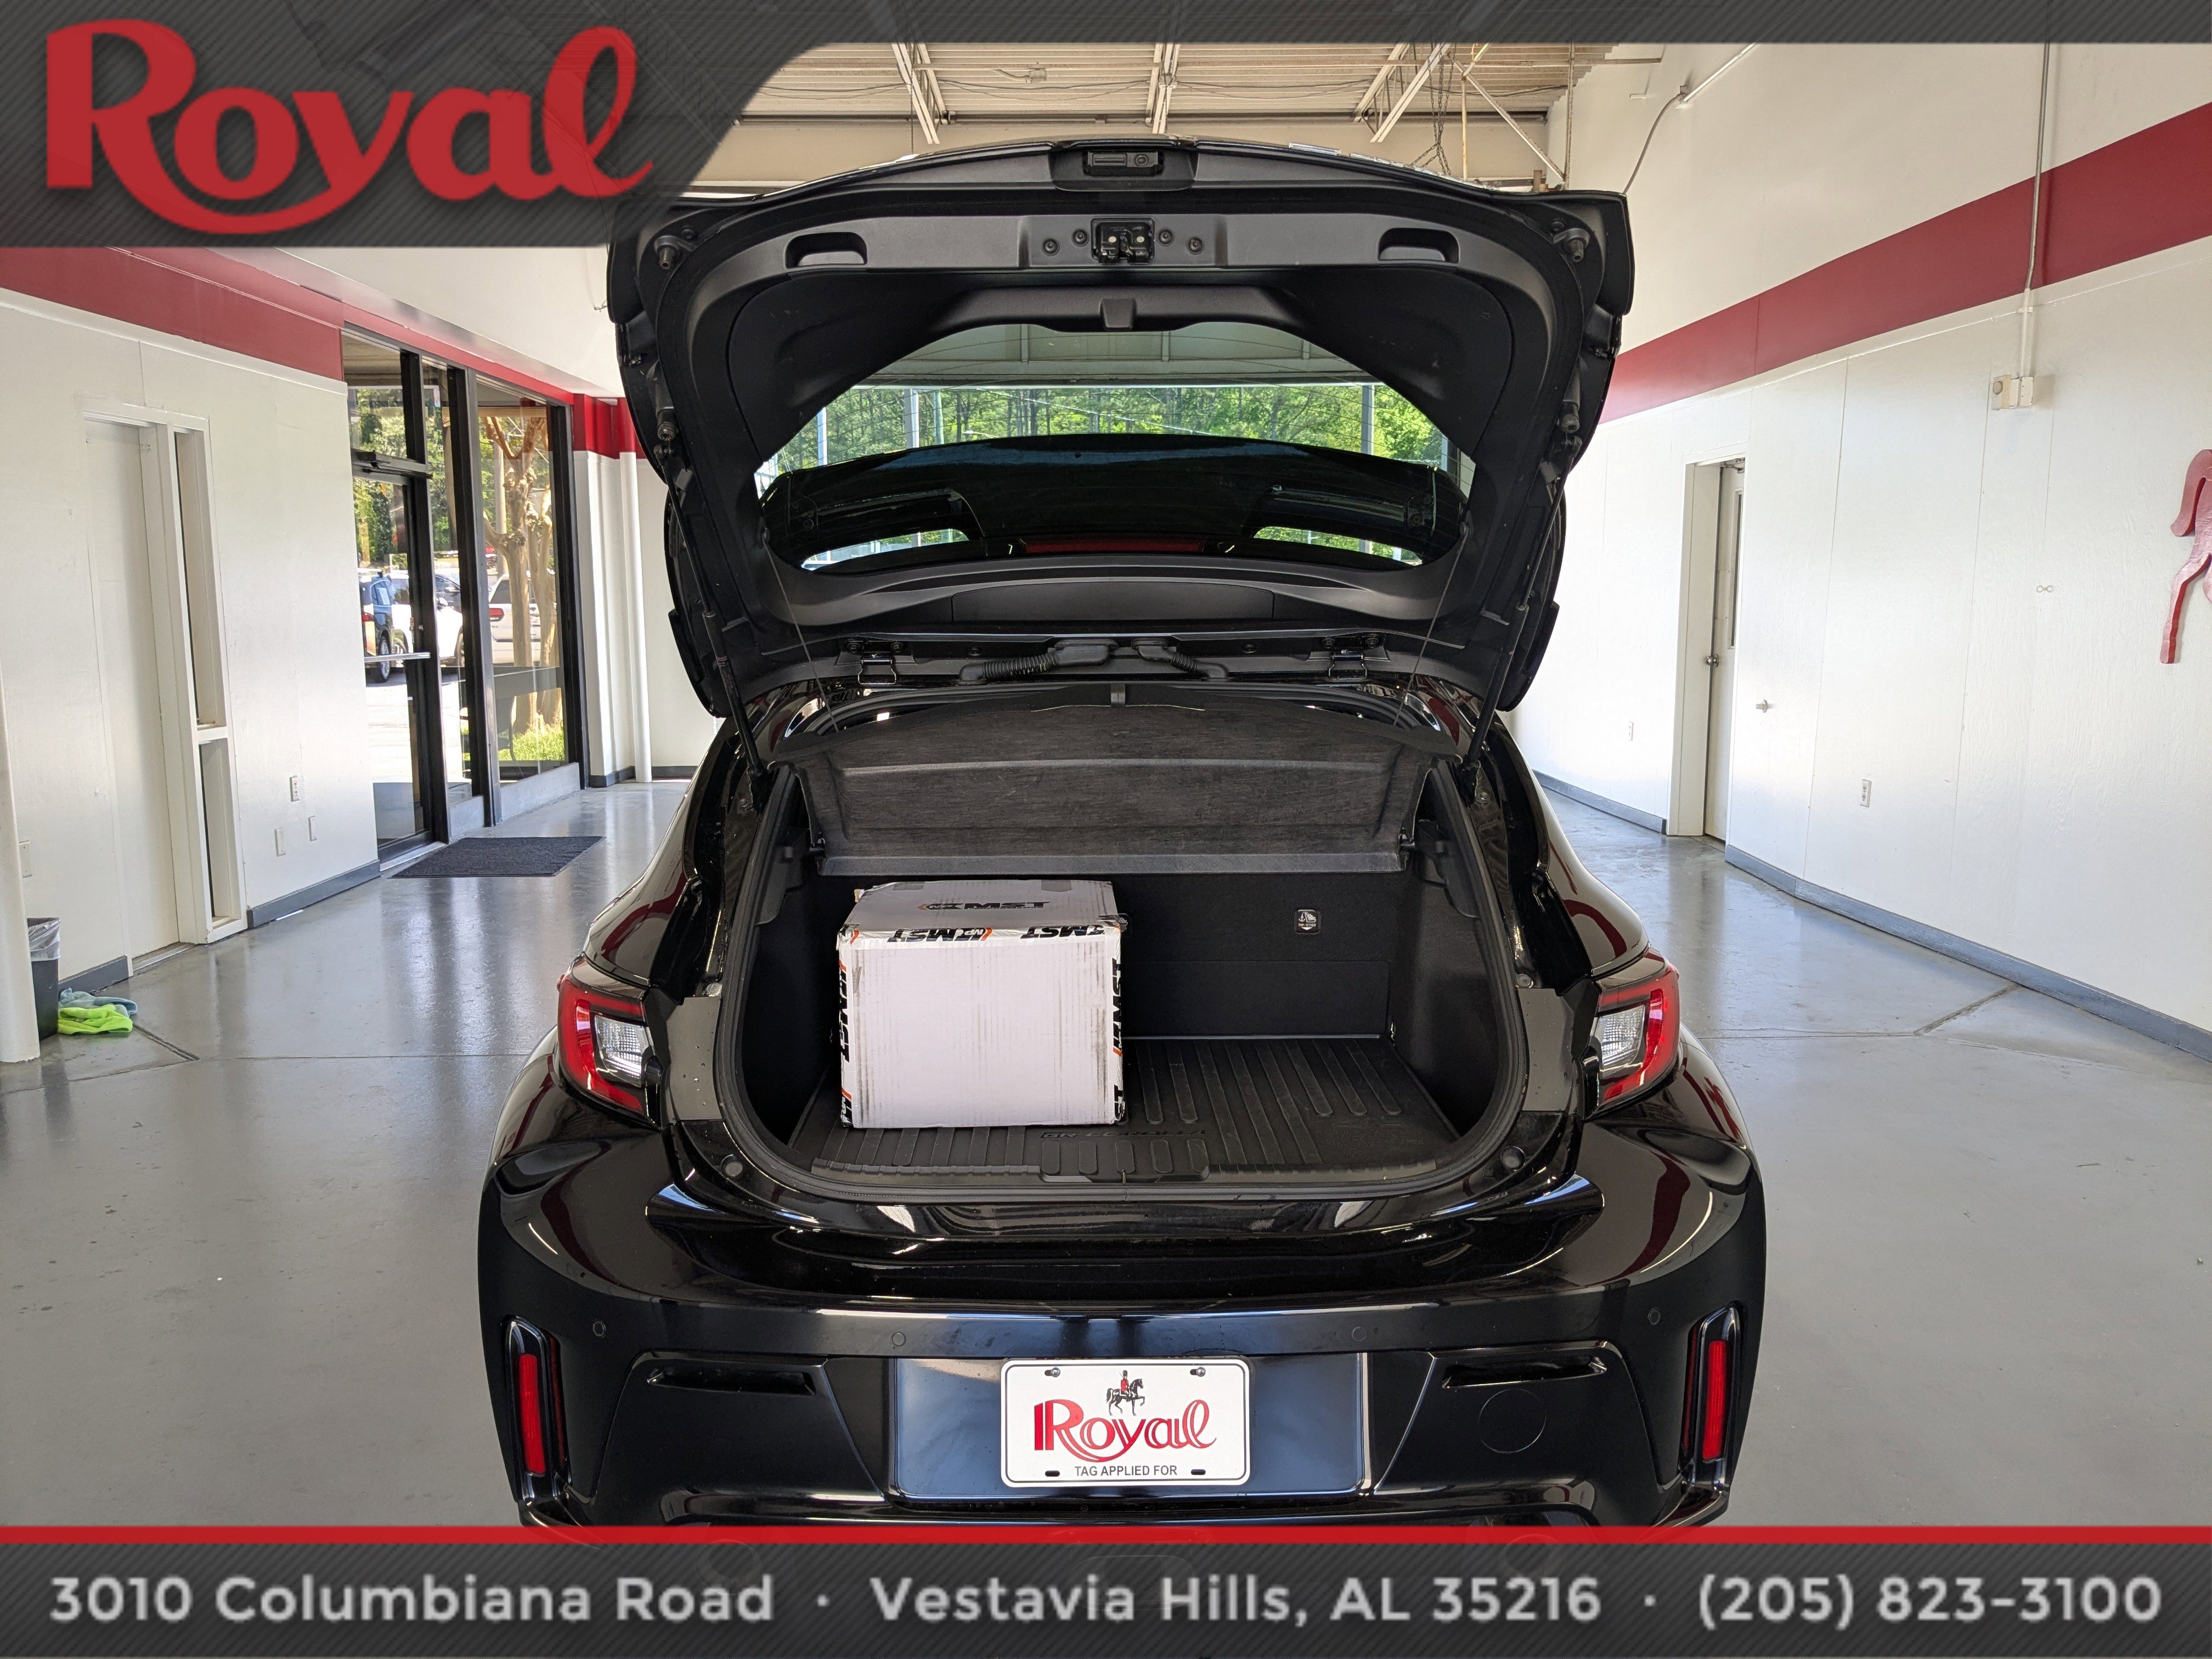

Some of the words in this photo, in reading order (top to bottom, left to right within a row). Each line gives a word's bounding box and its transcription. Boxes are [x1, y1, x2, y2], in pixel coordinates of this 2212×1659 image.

[963, 901, 1050, 910] MST
[887, 927, 958, 942] MST
[1020, 924, 1090, 939] MST
[1034, 1399, 1216, 1463] Royal
[1075, 1466, 1097, 1476] TAG
[1101, 1465, 1149, 1476] APPLIED
[1154, 1465, 1177, 1475] FOR
